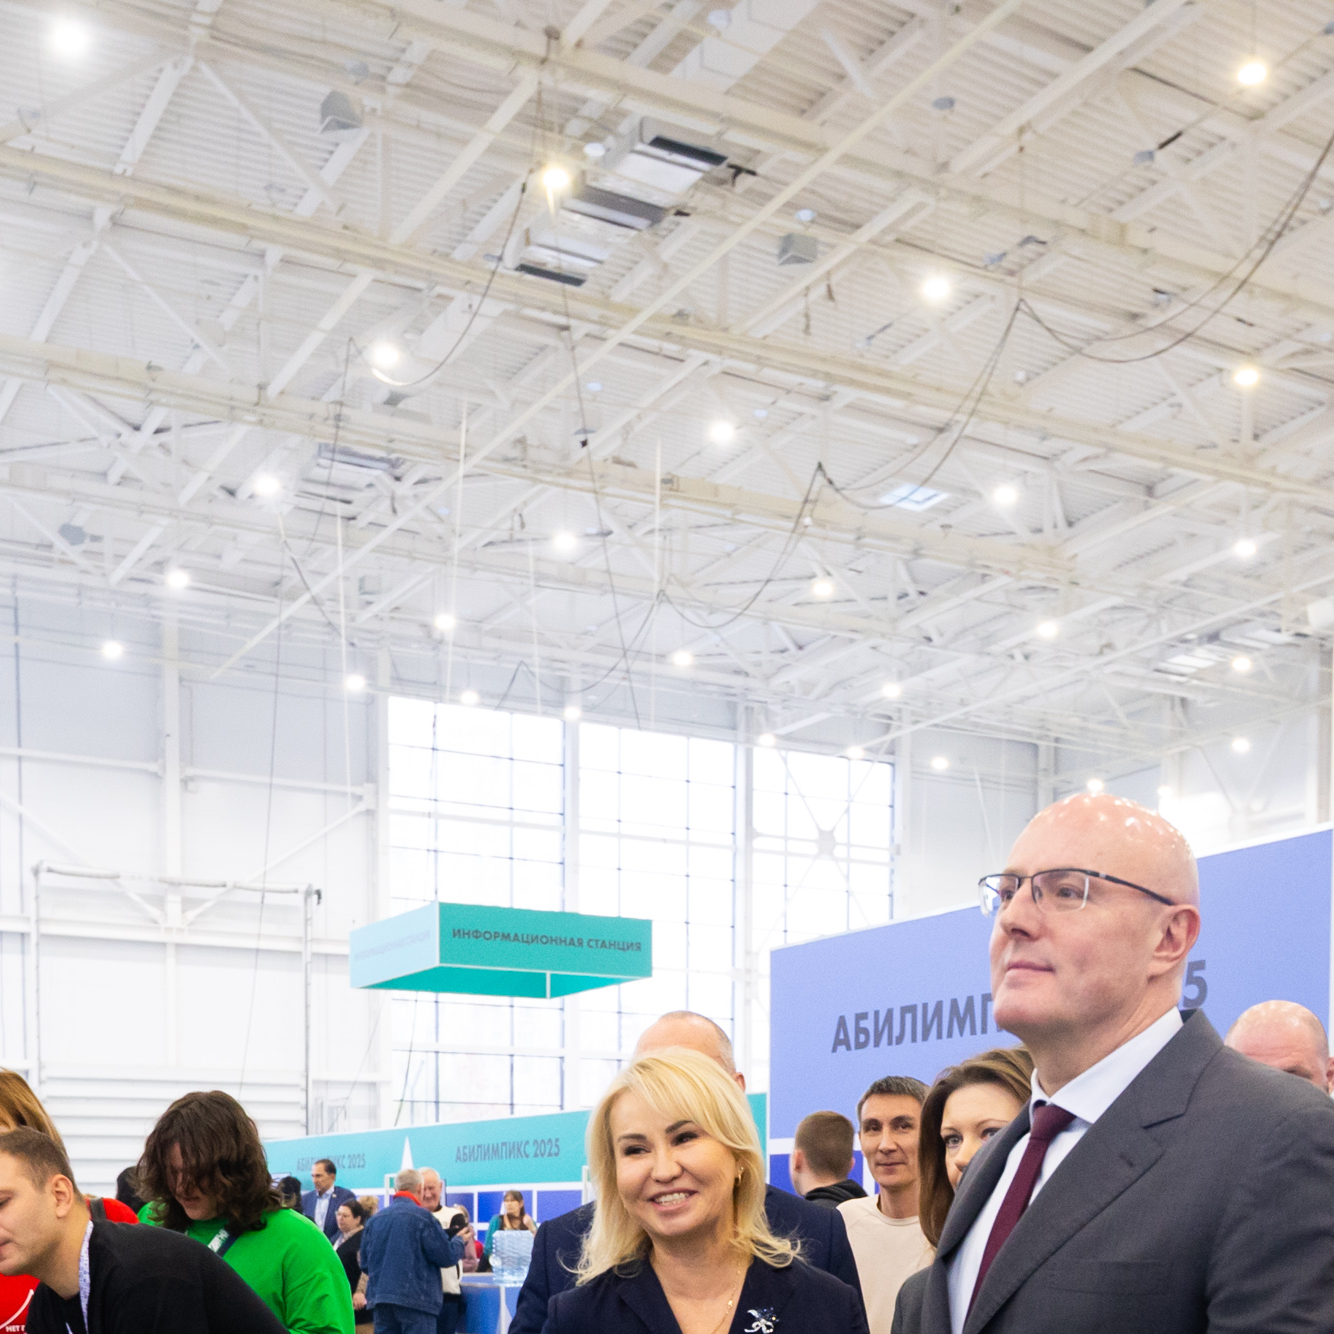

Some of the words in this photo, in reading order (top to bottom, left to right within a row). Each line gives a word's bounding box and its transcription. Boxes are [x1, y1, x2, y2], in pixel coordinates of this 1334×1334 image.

[452, 928, 584, 948] ИНФОРМАЦИОННАЯ
[586, 938, 642, 952] СТАНЦИЯ
[455, 1140, 530, 1163] АБИЛИМПИКС
[532, 1138, 561, 1158] 2025
